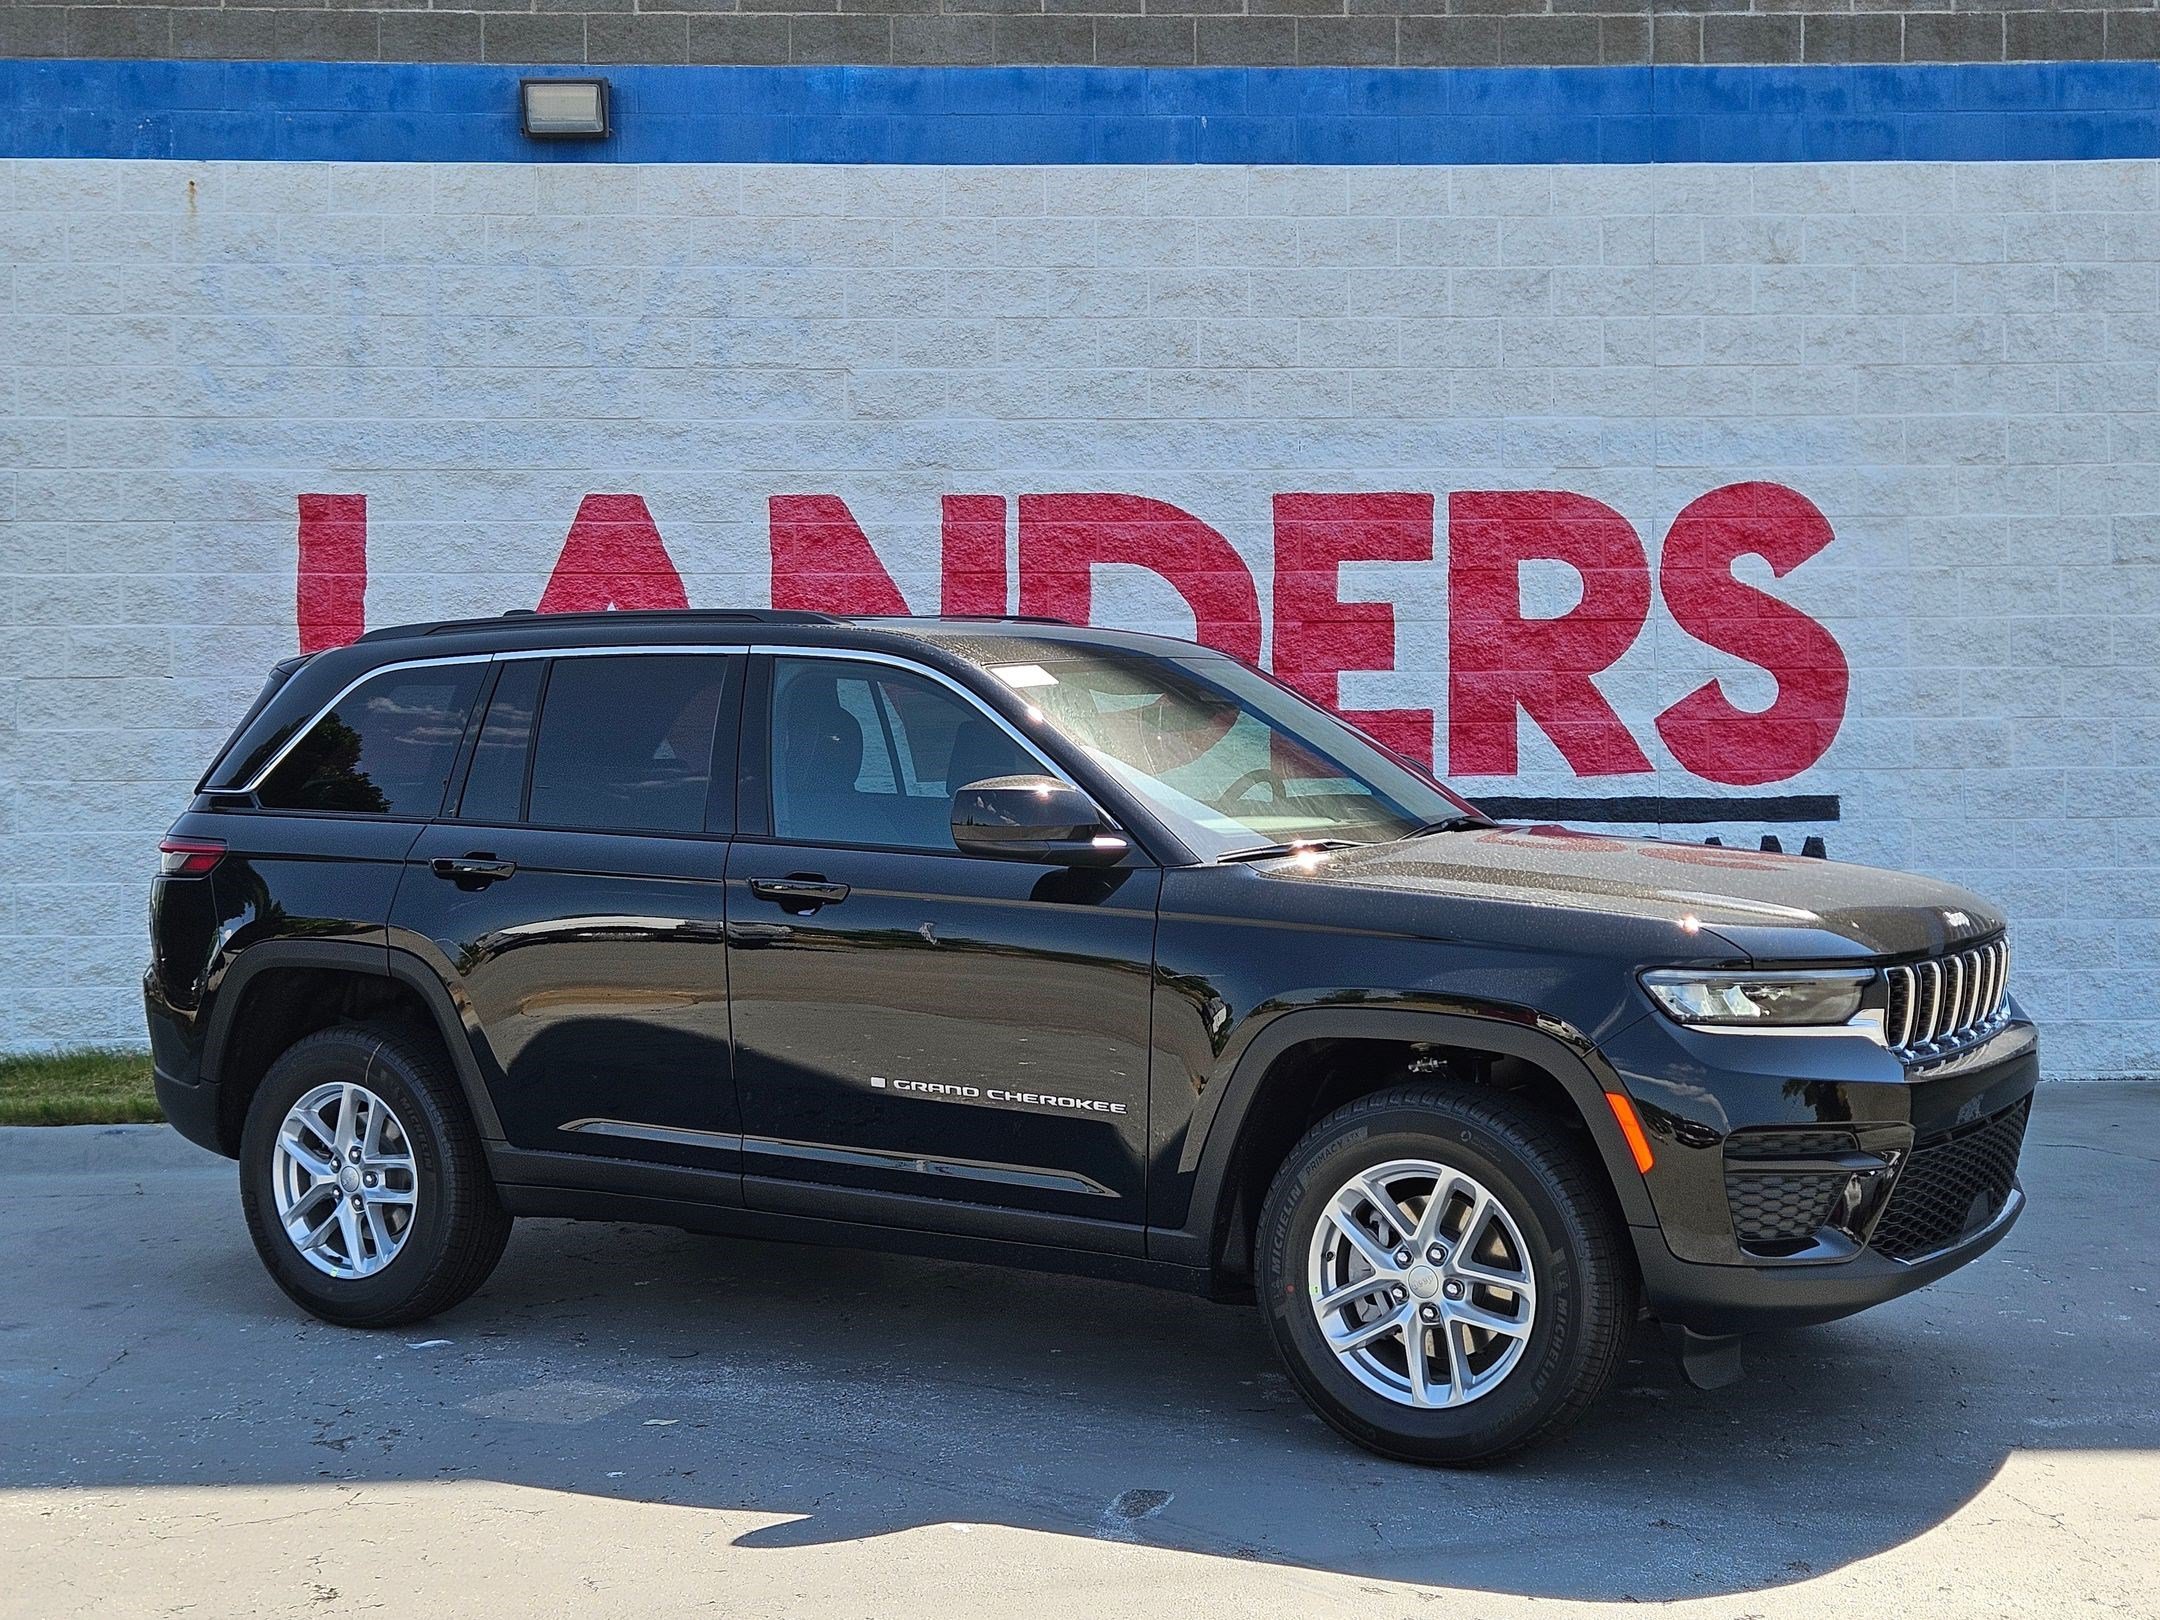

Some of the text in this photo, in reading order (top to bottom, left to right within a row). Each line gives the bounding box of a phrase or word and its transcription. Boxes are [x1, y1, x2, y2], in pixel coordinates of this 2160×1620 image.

[893, 1079, 1127, 1114] GRAND CHEROKEE
[1271, 1183, 1301, 1275] MICHELIN
[1305, 1138, 1344, 1176] PRIMACY
[1536, 1297, 1568, 1391] MICHELIN
